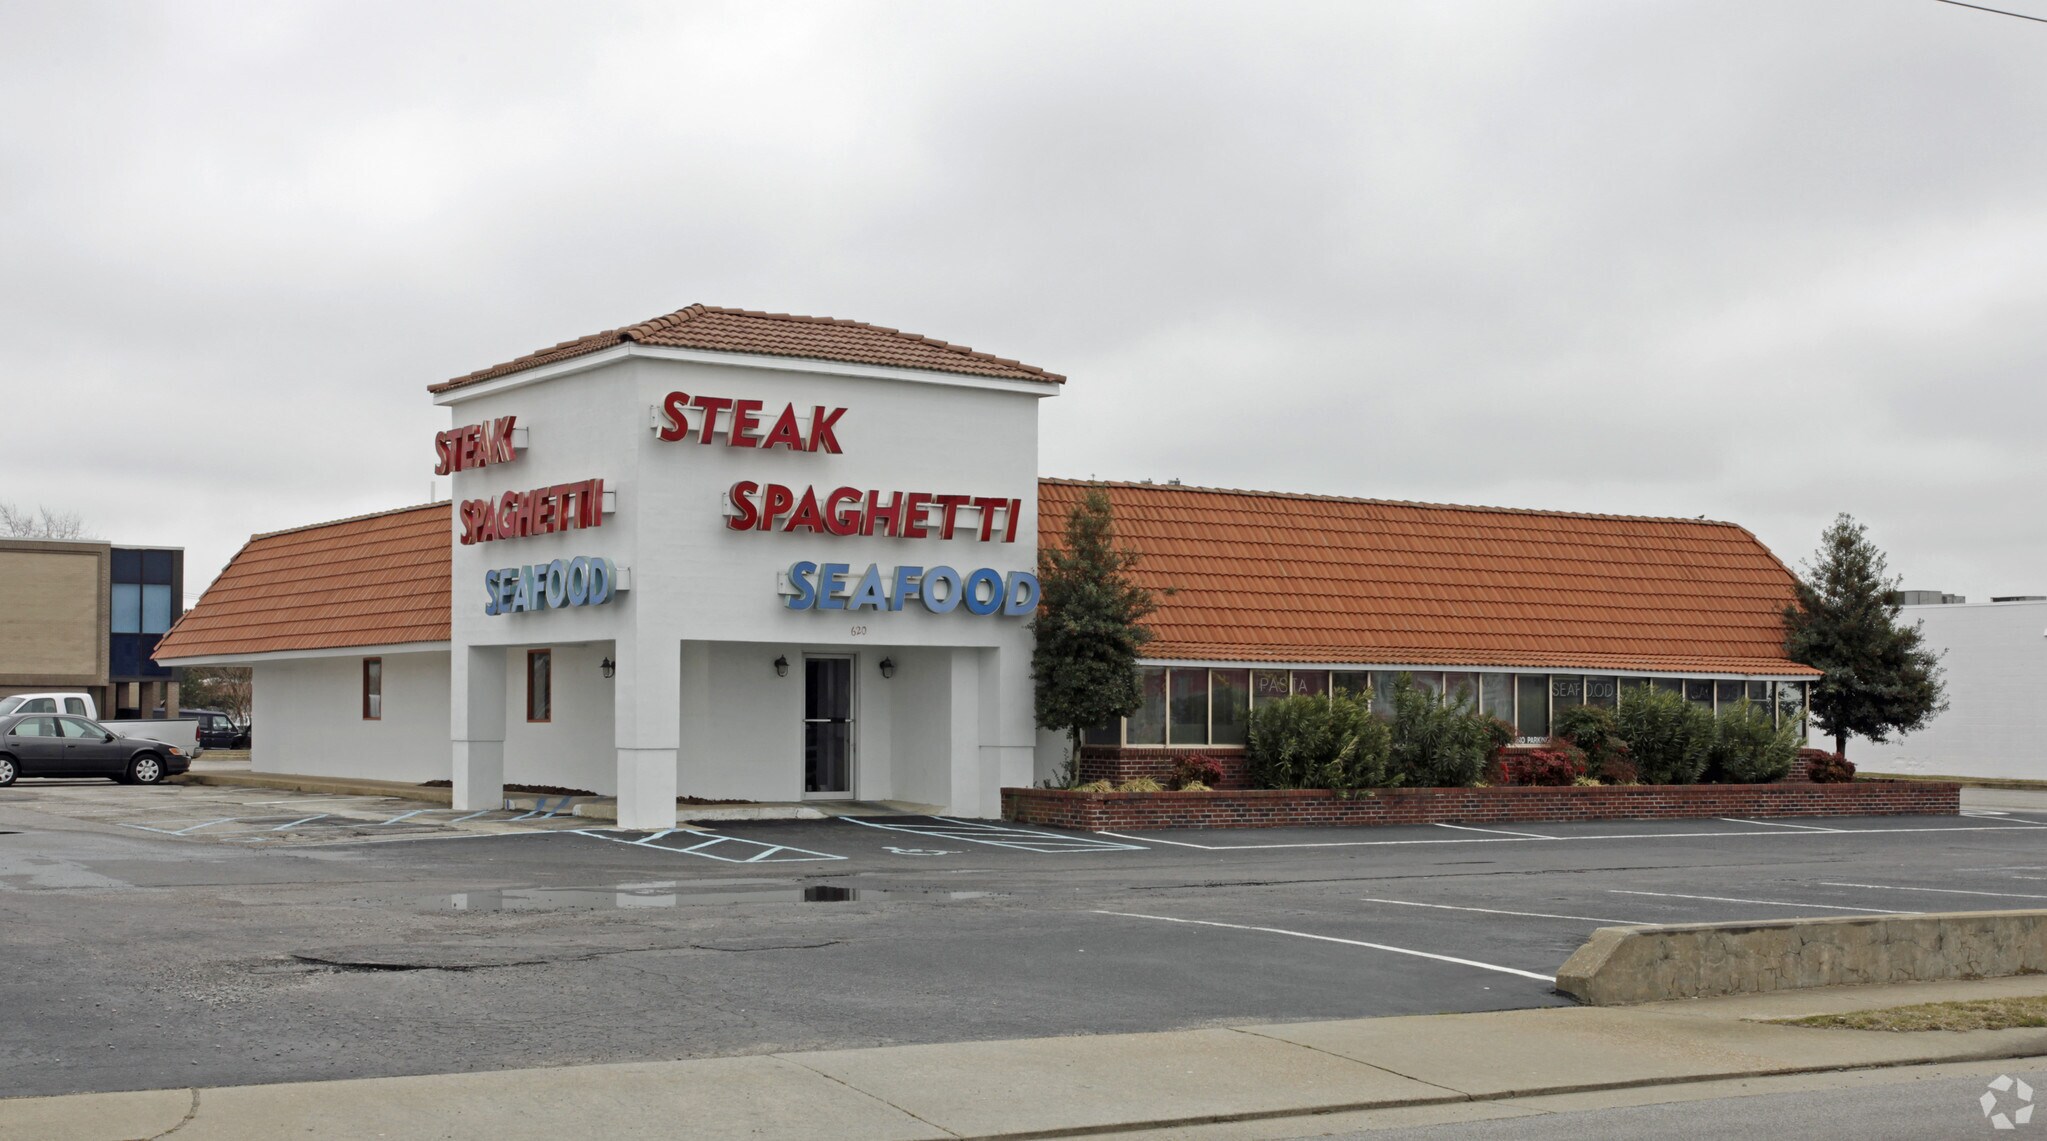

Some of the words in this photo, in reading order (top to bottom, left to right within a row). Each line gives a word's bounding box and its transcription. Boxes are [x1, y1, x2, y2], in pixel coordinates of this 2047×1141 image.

[434, 415, 516, 475] STEAK
[656, 391, 849, 454] STEAK
[460, 478, 604, 545] SPAGHETTI
[726, 480, 1022, 543] SPAGHETTI
[484, 556, 616, 616] SEAFOOD
[784, 560, 1041, 616] SEAFOOD
[850, 625, 867, 636] 620
